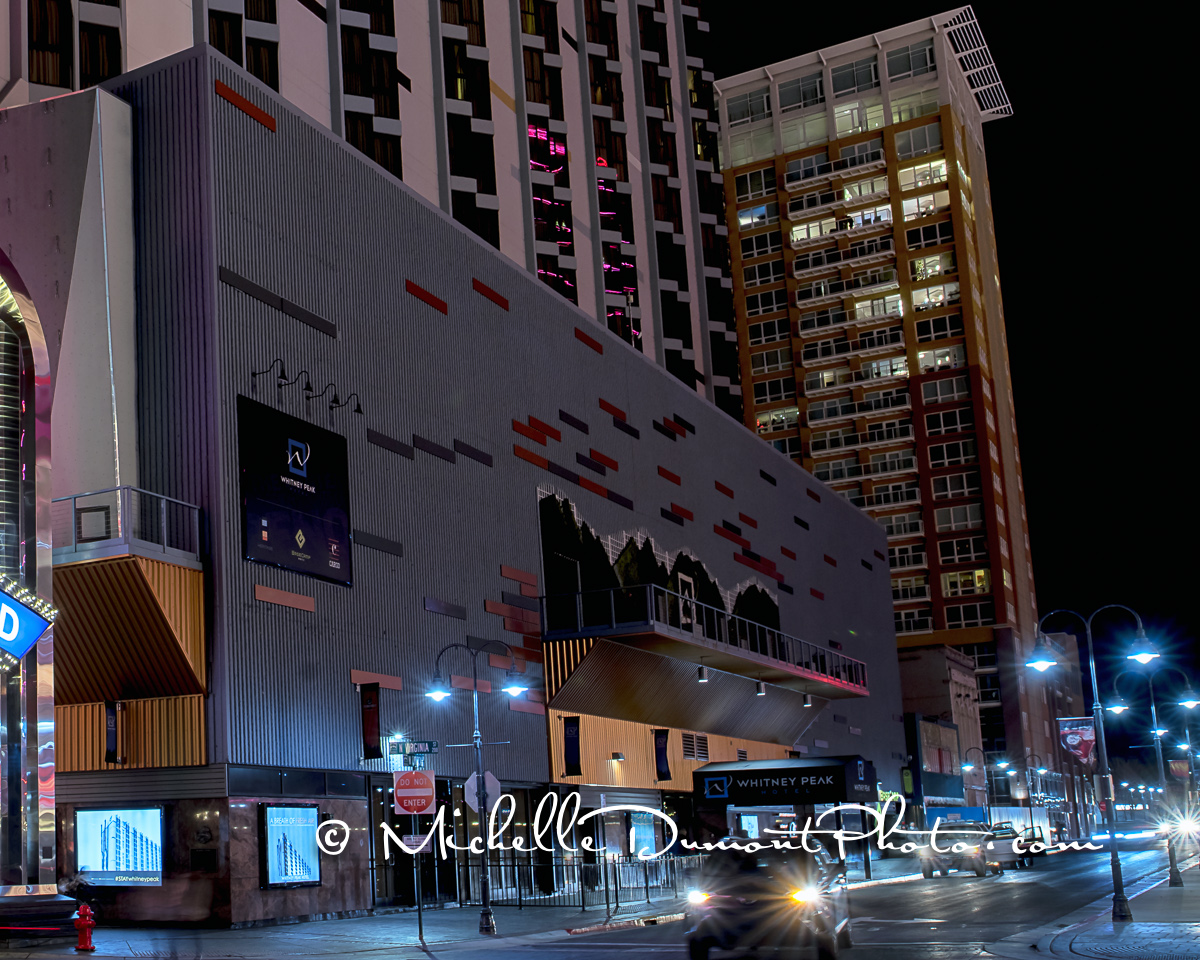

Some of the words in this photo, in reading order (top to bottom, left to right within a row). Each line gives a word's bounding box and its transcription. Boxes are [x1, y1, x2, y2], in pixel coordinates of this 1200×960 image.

[280, 475, 303, 490] WHITNEY
[400, 778, 410, 786] DO
[414, 777, 428, 786] NOT
[736, 776, 797, 788] WHITNEY
[801, 775, 834, 786] PEAK
[403, 799, 427, 807] ENTER
[289, 817, 296, 825] OF
